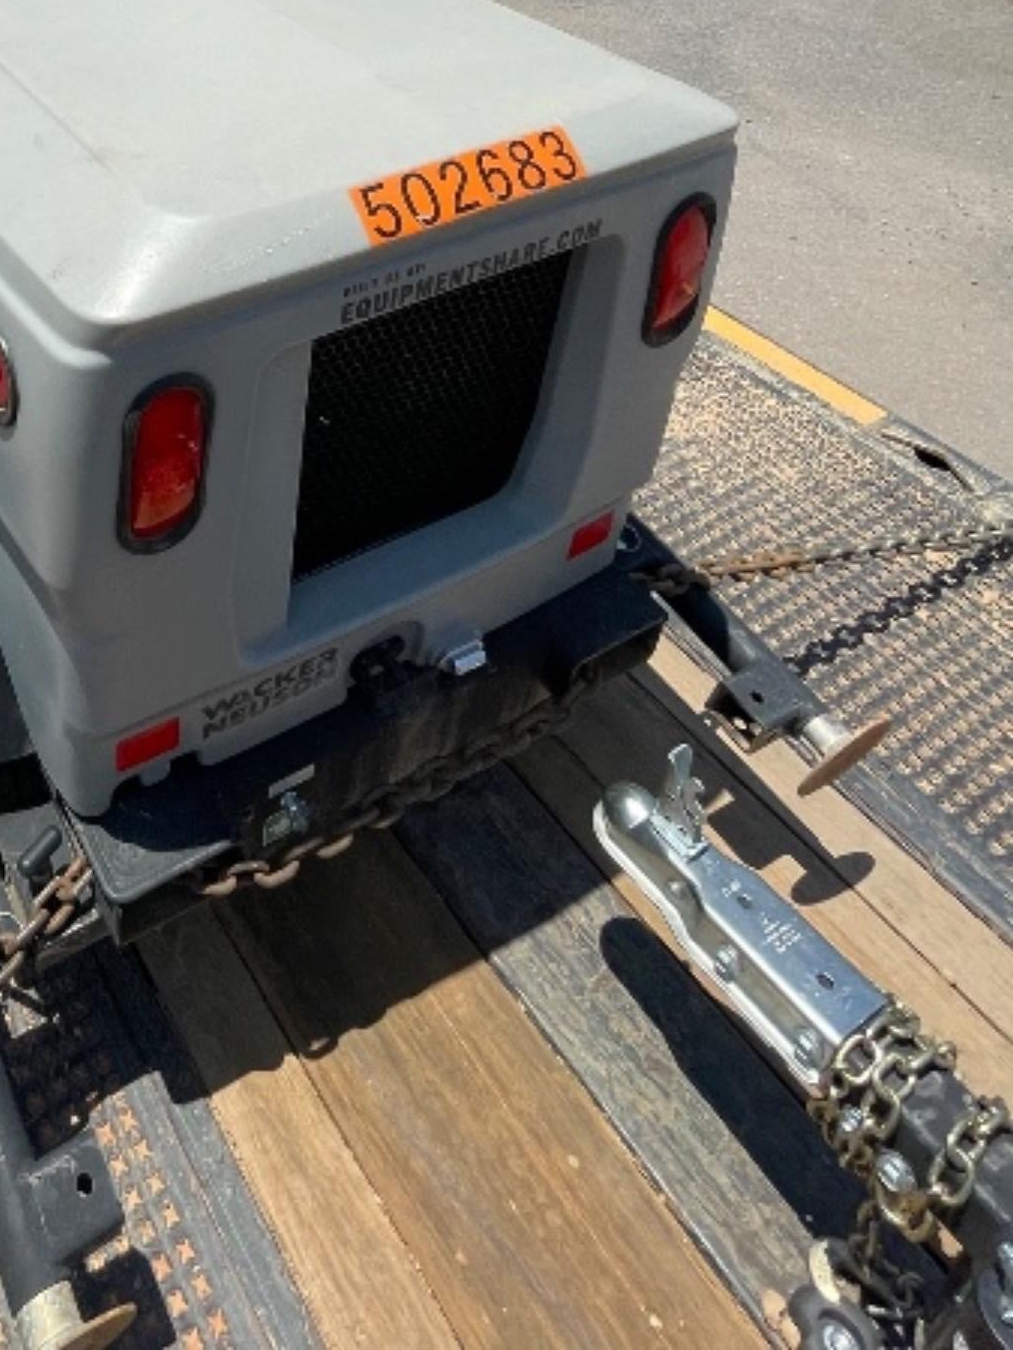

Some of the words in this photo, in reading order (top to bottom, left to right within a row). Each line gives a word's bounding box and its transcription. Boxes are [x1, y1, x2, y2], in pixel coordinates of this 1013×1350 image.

[358, 130, 579, 240] 502683
[340, 218, 604, 325] EQUIPMENTSHARE.COM
[201, 647, 339, 720] WACKER
